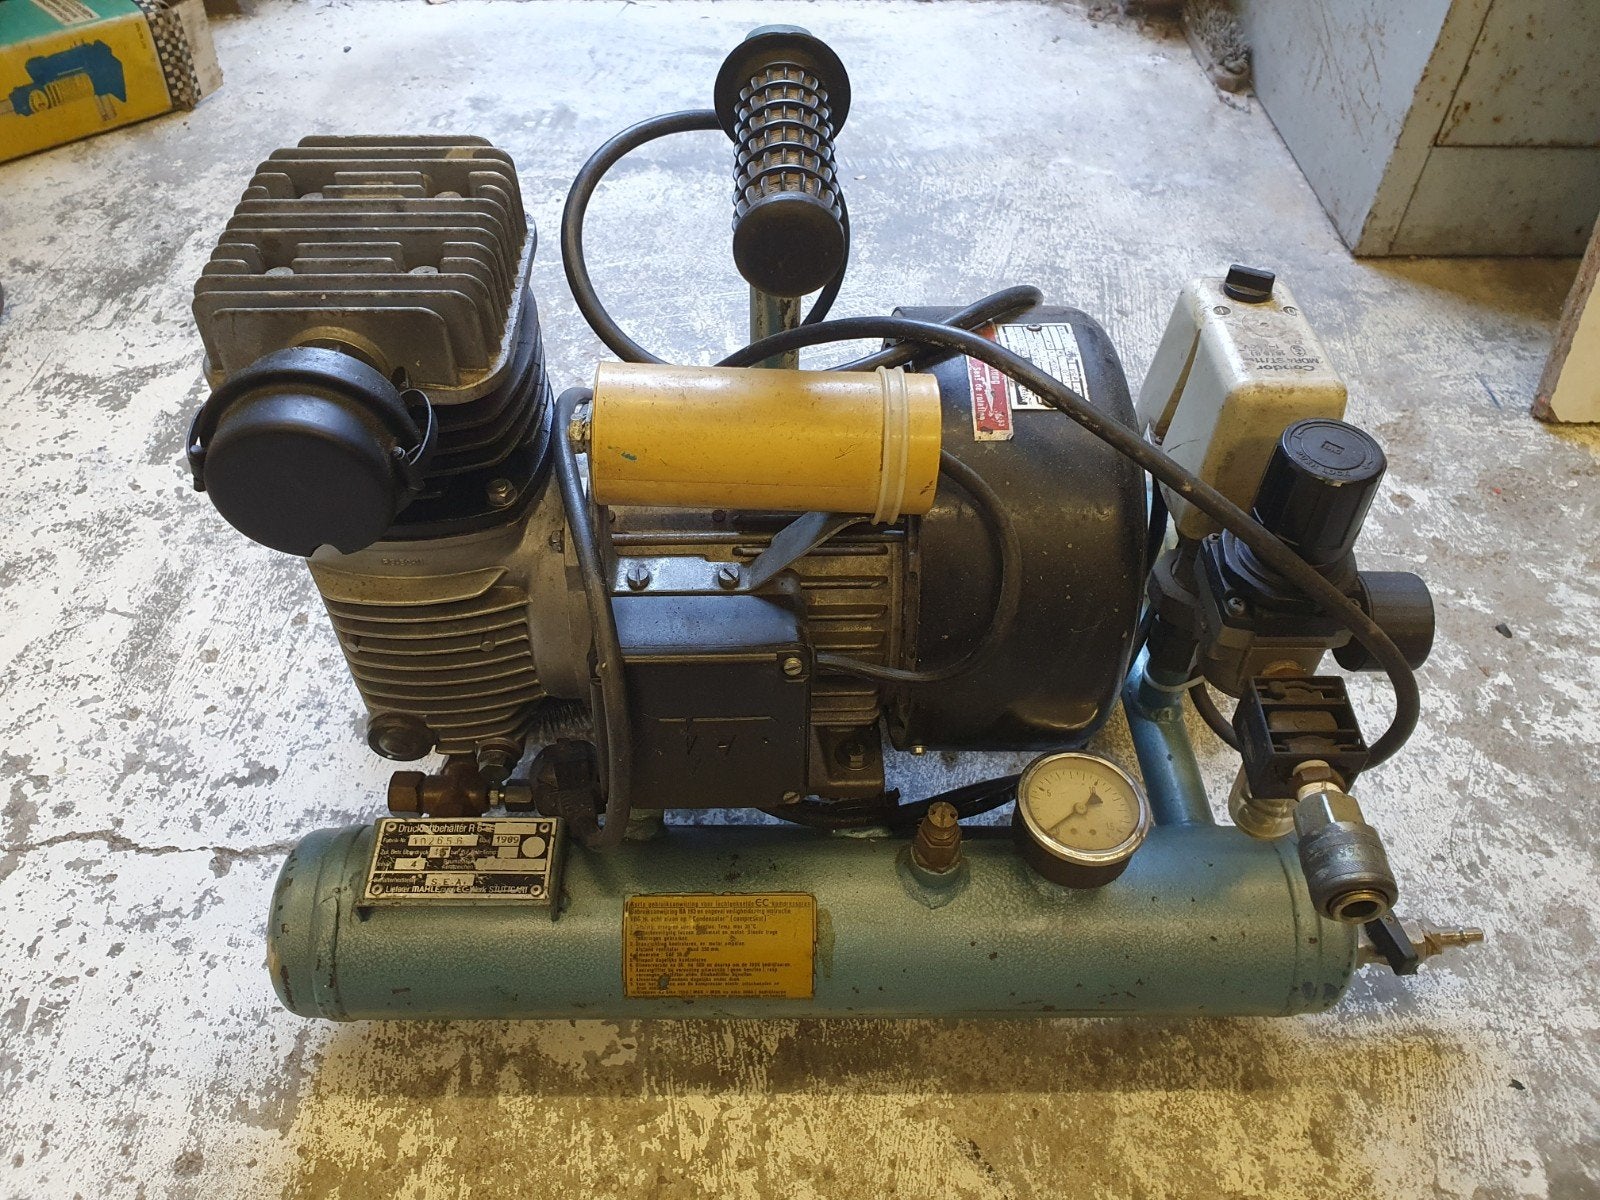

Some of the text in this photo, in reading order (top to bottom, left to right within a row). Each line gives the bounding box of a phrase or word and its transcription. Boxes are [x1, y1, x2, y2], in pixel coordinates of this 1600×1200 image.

[496, 835, 520, 844] 1989
[410, 860, 417, 868] 4
[411, 884, 440, 893] MAHLE
[755, 898, 770, 907] EC
